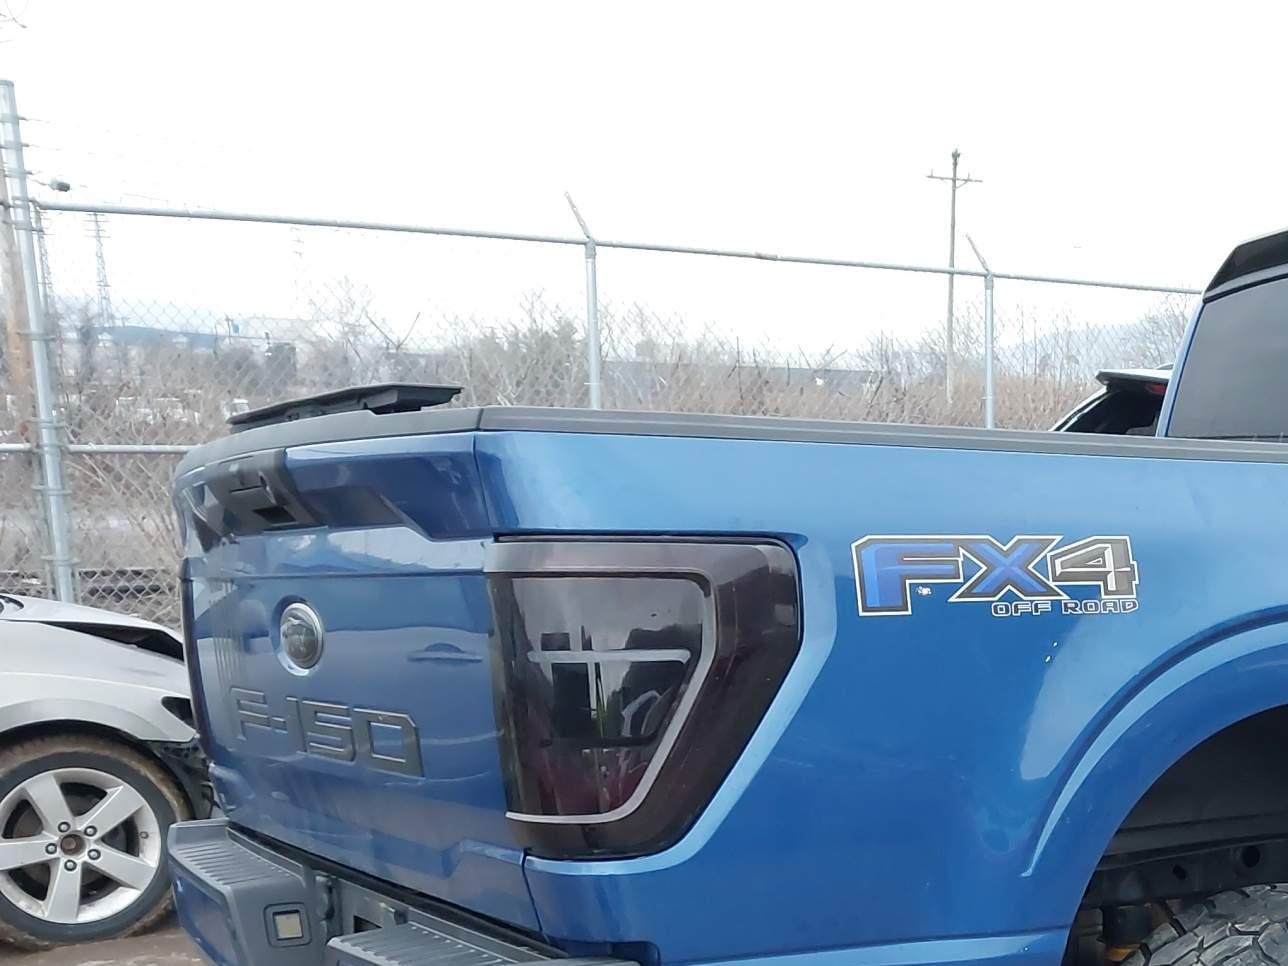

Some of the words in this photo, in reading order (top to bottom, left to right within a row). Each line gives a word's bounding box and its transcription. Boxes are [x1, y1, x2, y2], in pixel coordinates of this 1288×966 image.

[851, 535, 1139, 616] FX4
[991, 601, 1052, 617] OFF
[1062, 599, 1139, 615] ROAD
[230, 686, 426, 781] F-150
